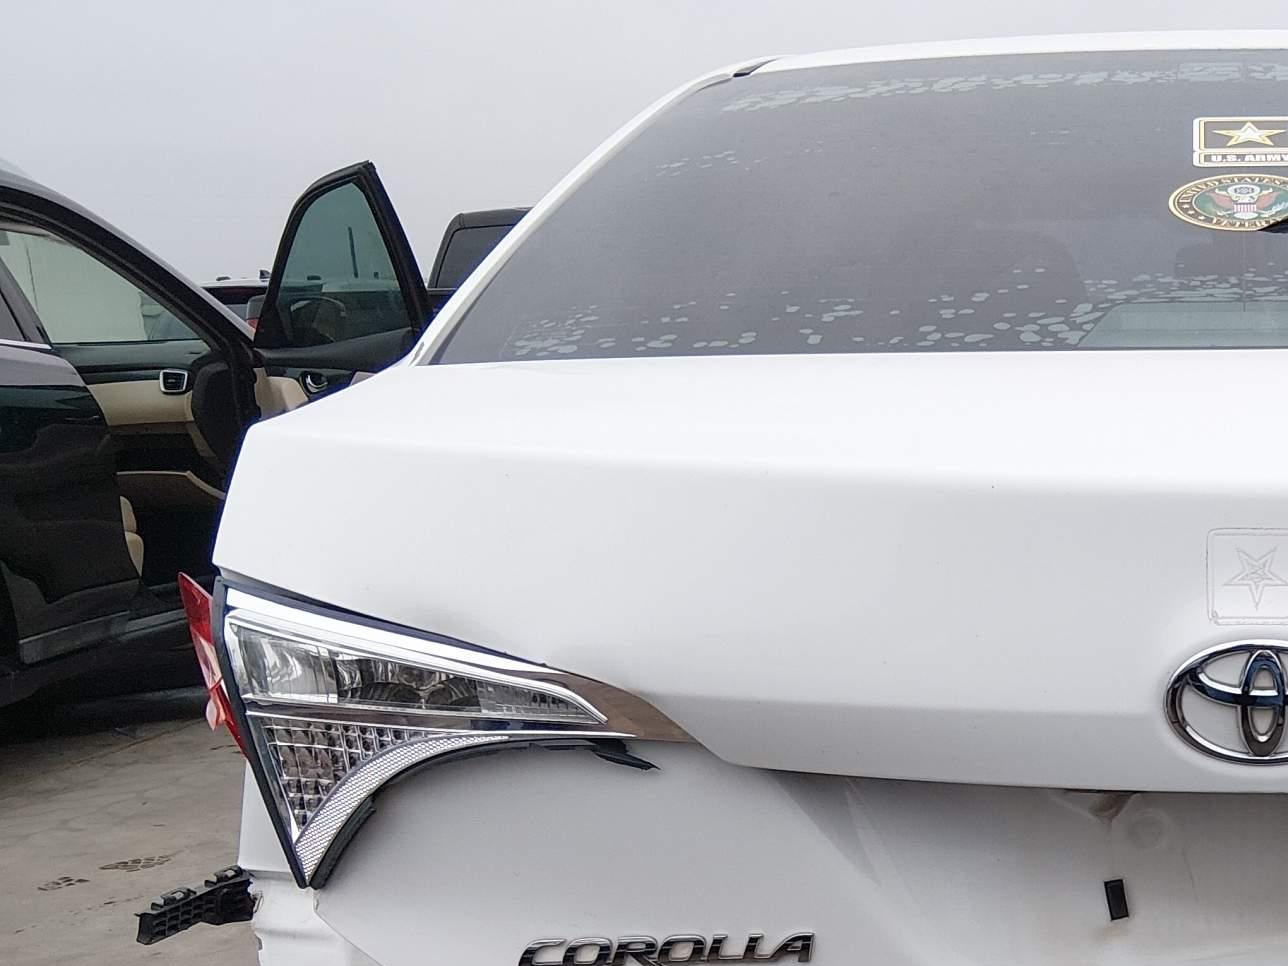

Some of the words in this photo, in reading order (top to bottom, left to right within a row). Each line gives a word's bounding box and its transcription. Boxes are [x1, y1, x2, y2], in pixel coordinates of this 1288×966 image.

[1210, 154, 1240, 163] U.S.
[1179, 180, 1218, 203] UNITED
[1220, 177, 1281, 185] STATES
